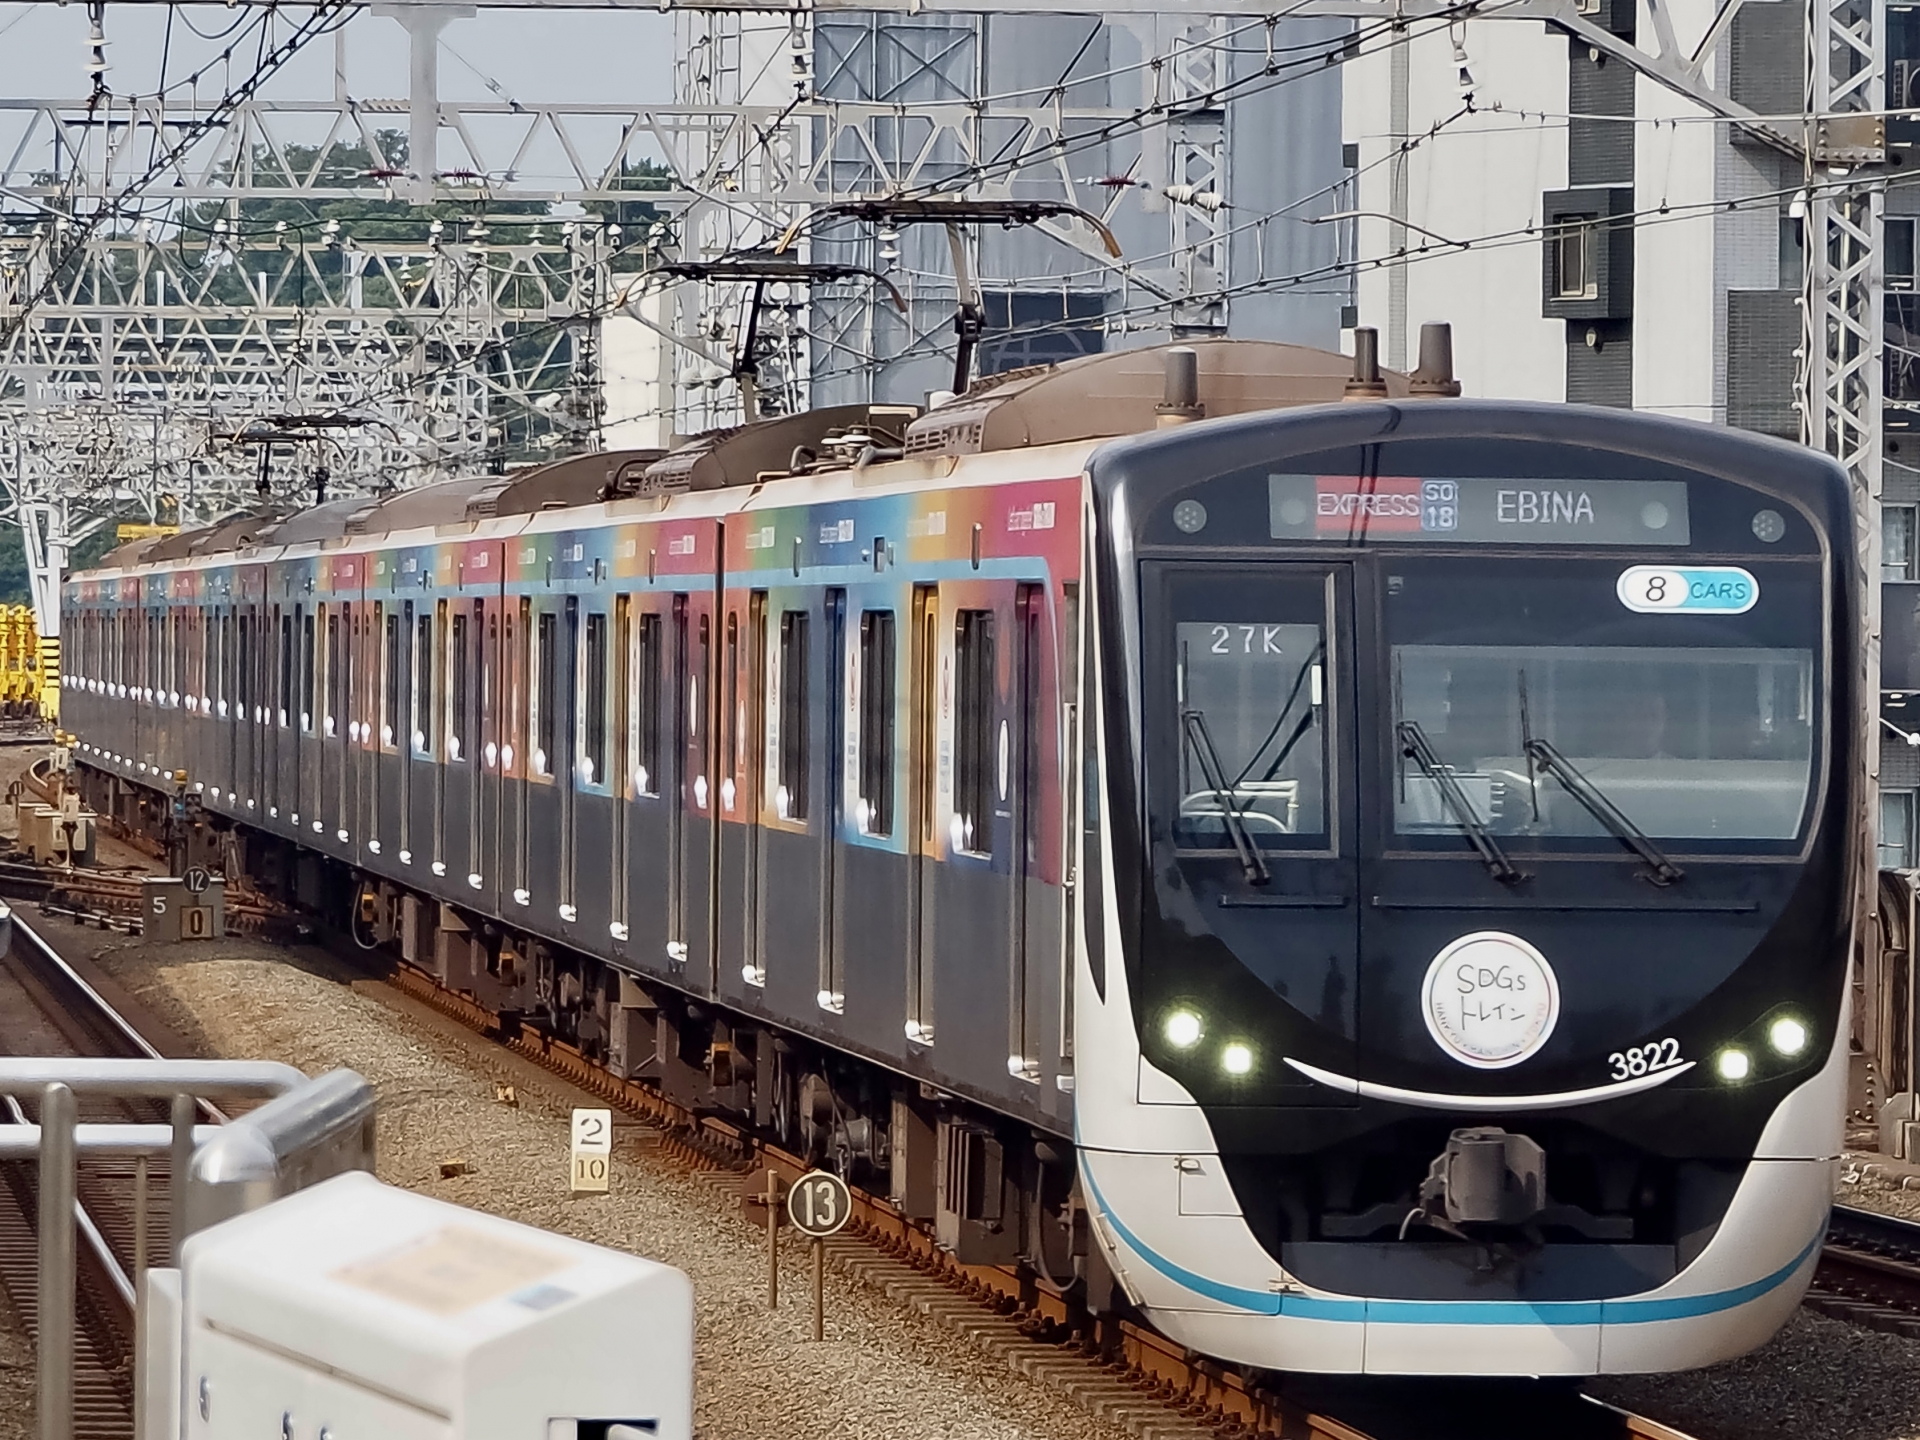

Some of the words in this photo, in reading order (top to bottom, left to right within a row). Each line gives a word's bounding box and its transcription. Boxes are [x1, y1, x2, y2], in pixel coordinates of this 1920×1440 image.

[1316, 493, 1421, 517] EXPRESS
[1427, 505, 1454, 528] 18
[1496, 489, 1595, 524] EBINA
[1645, 576, 1667, 602] 8
[1690, 581, 1747, 601] CARS
[189, 870, 205, 892] 12
[152, 896, 167, 914] 5
[190, 909, 204, 936] 0
[1456, 963, 1527, 995] SDGs
[1460, 995, 1526, 1031] トレイン
[1608, 1037, 1684, 1081] 3822
[579, 1116, 604, 1147] 2
[577, 1159, 606, 1181] 10
[802, 1180, 836, 1228] 13
